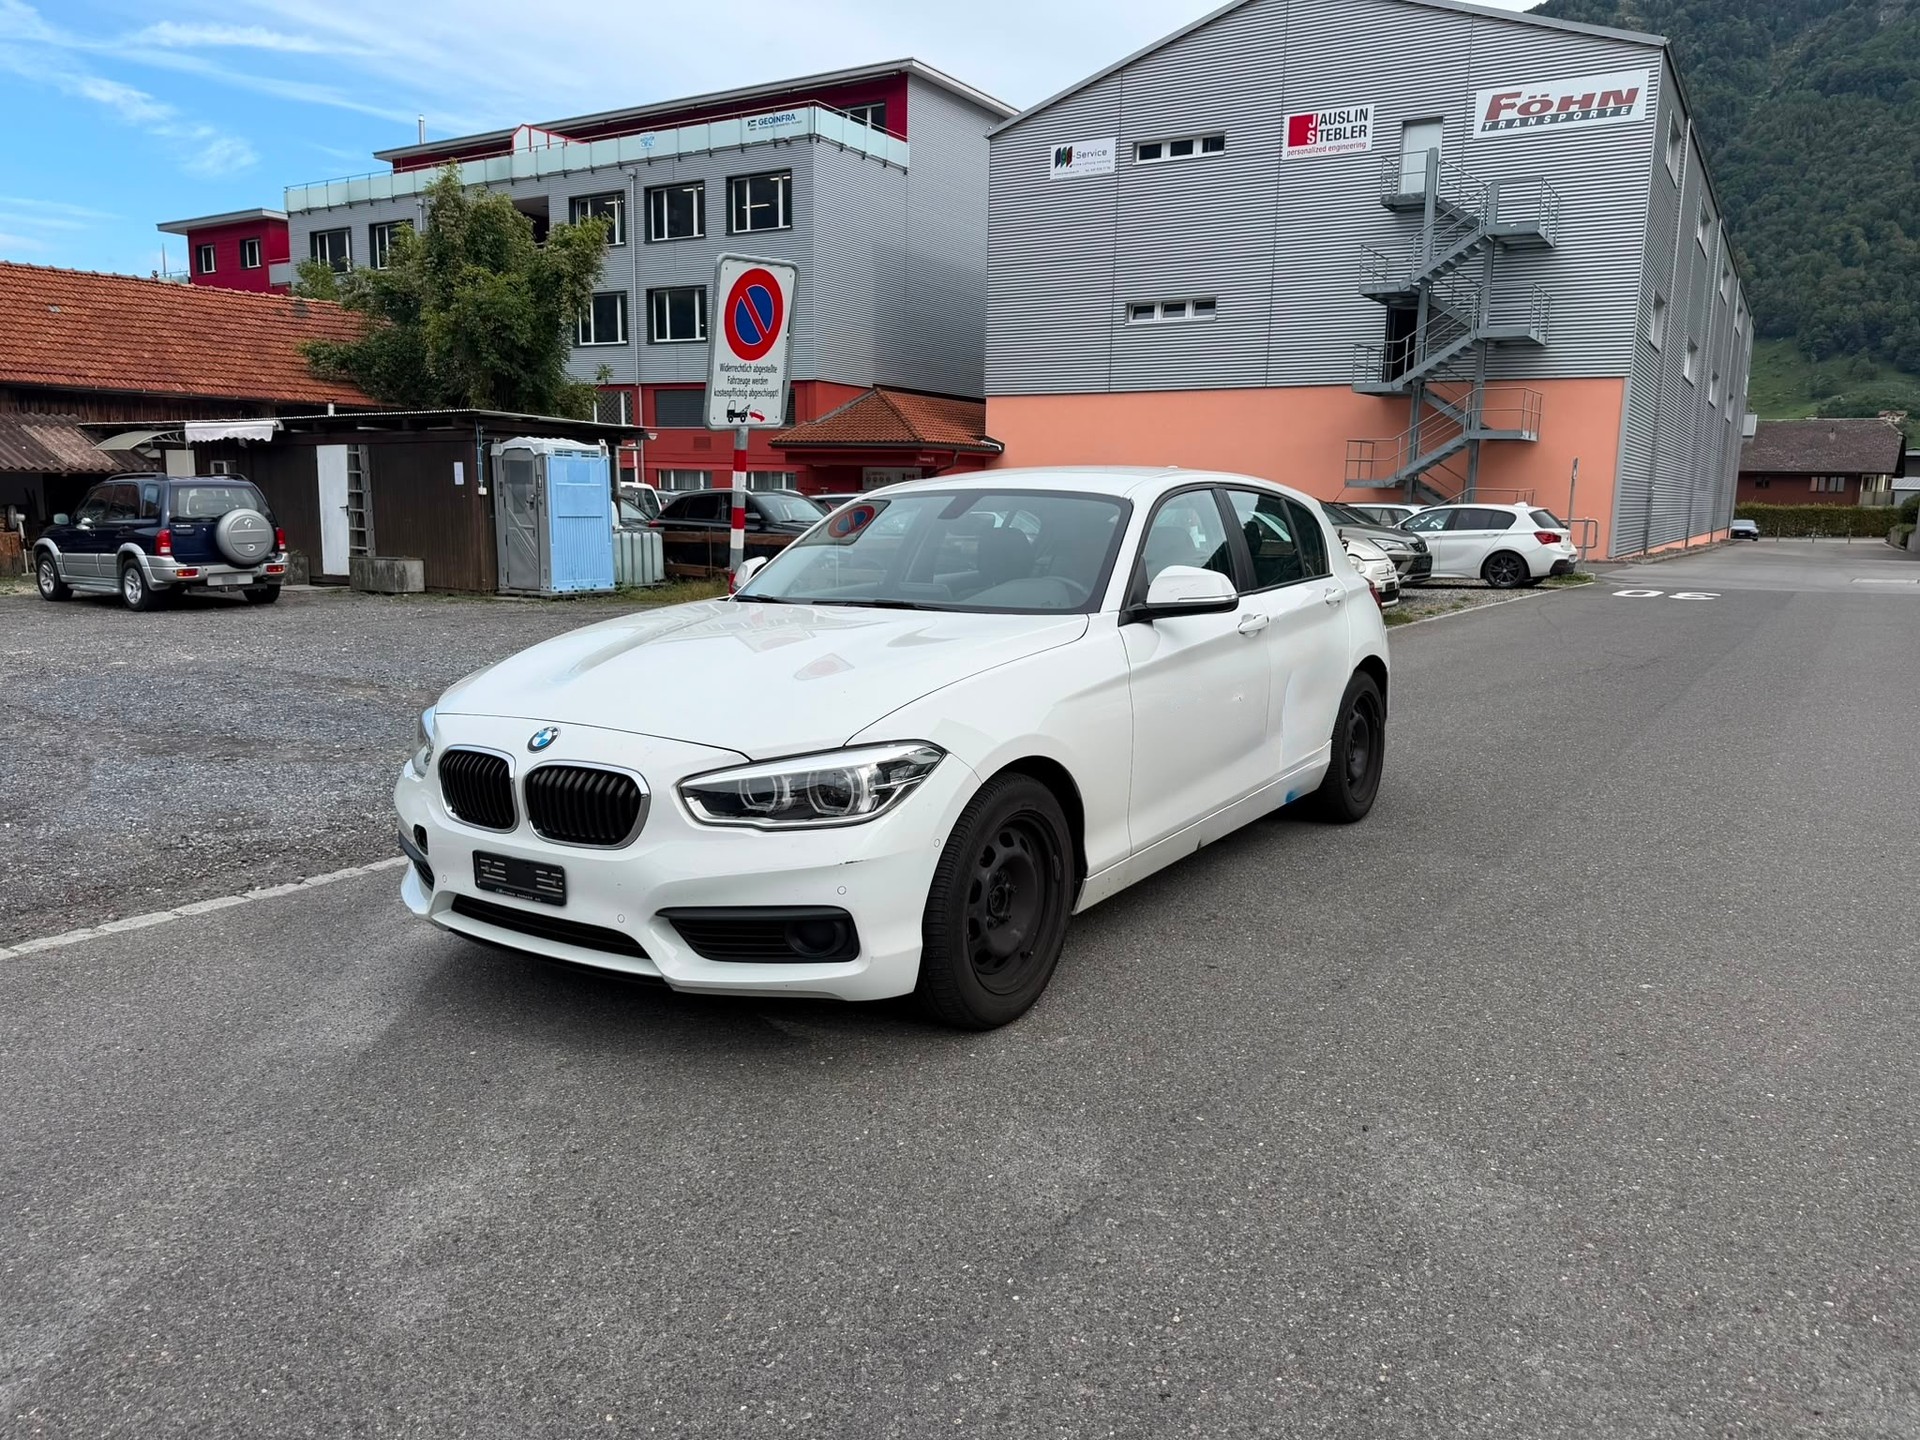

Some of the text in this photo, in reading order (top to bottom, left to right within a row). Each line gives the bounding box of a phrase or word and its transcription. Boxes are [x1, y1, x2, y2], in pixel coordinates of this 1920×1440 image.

[1484, 87, 1640, 121] FÖHN
[758, 113, 796, 126] GEOINFRA
[1308, 107, 1369, 129] JAUSLIN
[1484, 106, 1630, 131] TRANSPORTE
[1306, 124, 1367, 144] STEBLER
[1286, 141, 1367, 157] personalized engineering
[719, 363, 778, 375] Widerrechtlich abgestellte
[727, 375, 769, 387] Fahrzeuge werden
[713, 387, 748, 399] kostenpflichtig
